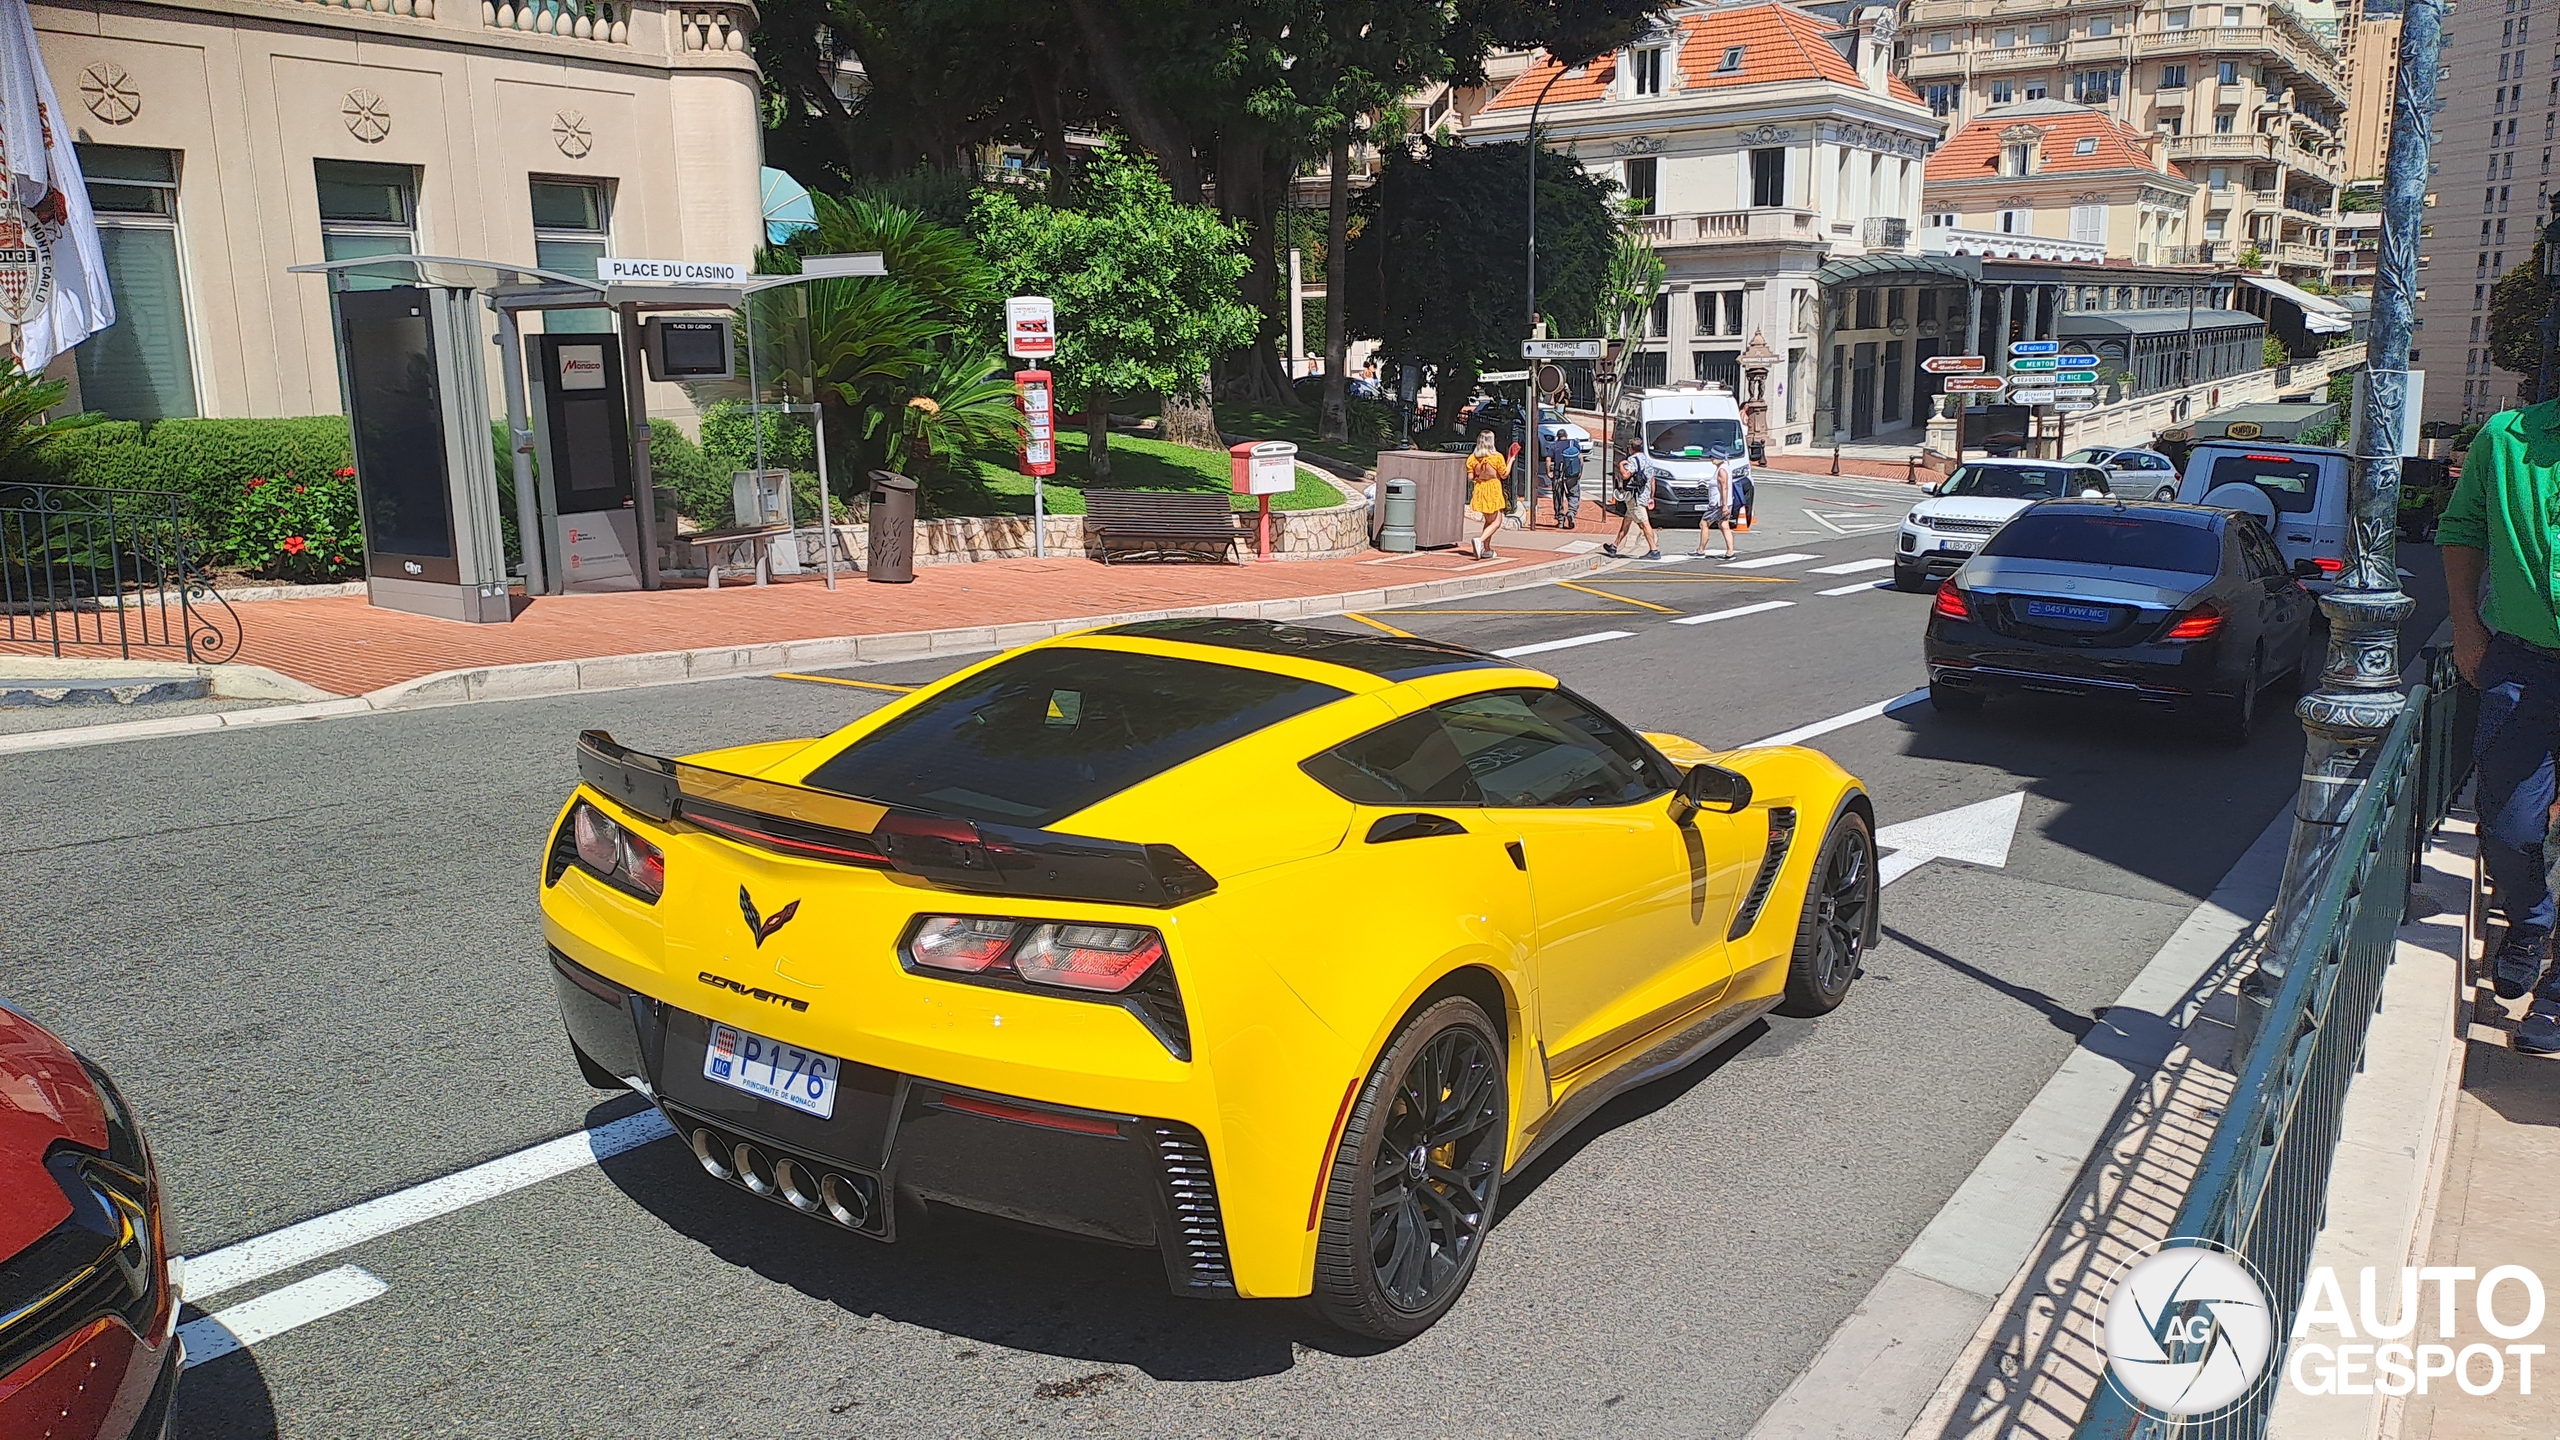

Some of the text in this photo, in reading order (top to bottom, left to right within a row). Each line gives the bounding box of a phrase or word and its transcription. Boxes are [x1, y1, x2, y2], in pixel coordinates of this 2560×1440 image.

[30, 222, 52, 304] MONTE-CARLO
[613, 263, 735, 279] PLACE DU CASINO
[563, 360, 601, 373] Monaco
[2026, 360, 2055, 368] MENTON
[2045, 604, 2066, 614] 0451
[2068, 606, 2087, 616] WW
[2088, 609, 2104, 618] MC
[698, 971, 810, 1013] CORVETTE
[714, 1059, 728, 1075] MC
[741, 1036, 827, 1100] P176
[742, 1078, 816, 1108] PRINCIPAUTE DE MONACO
